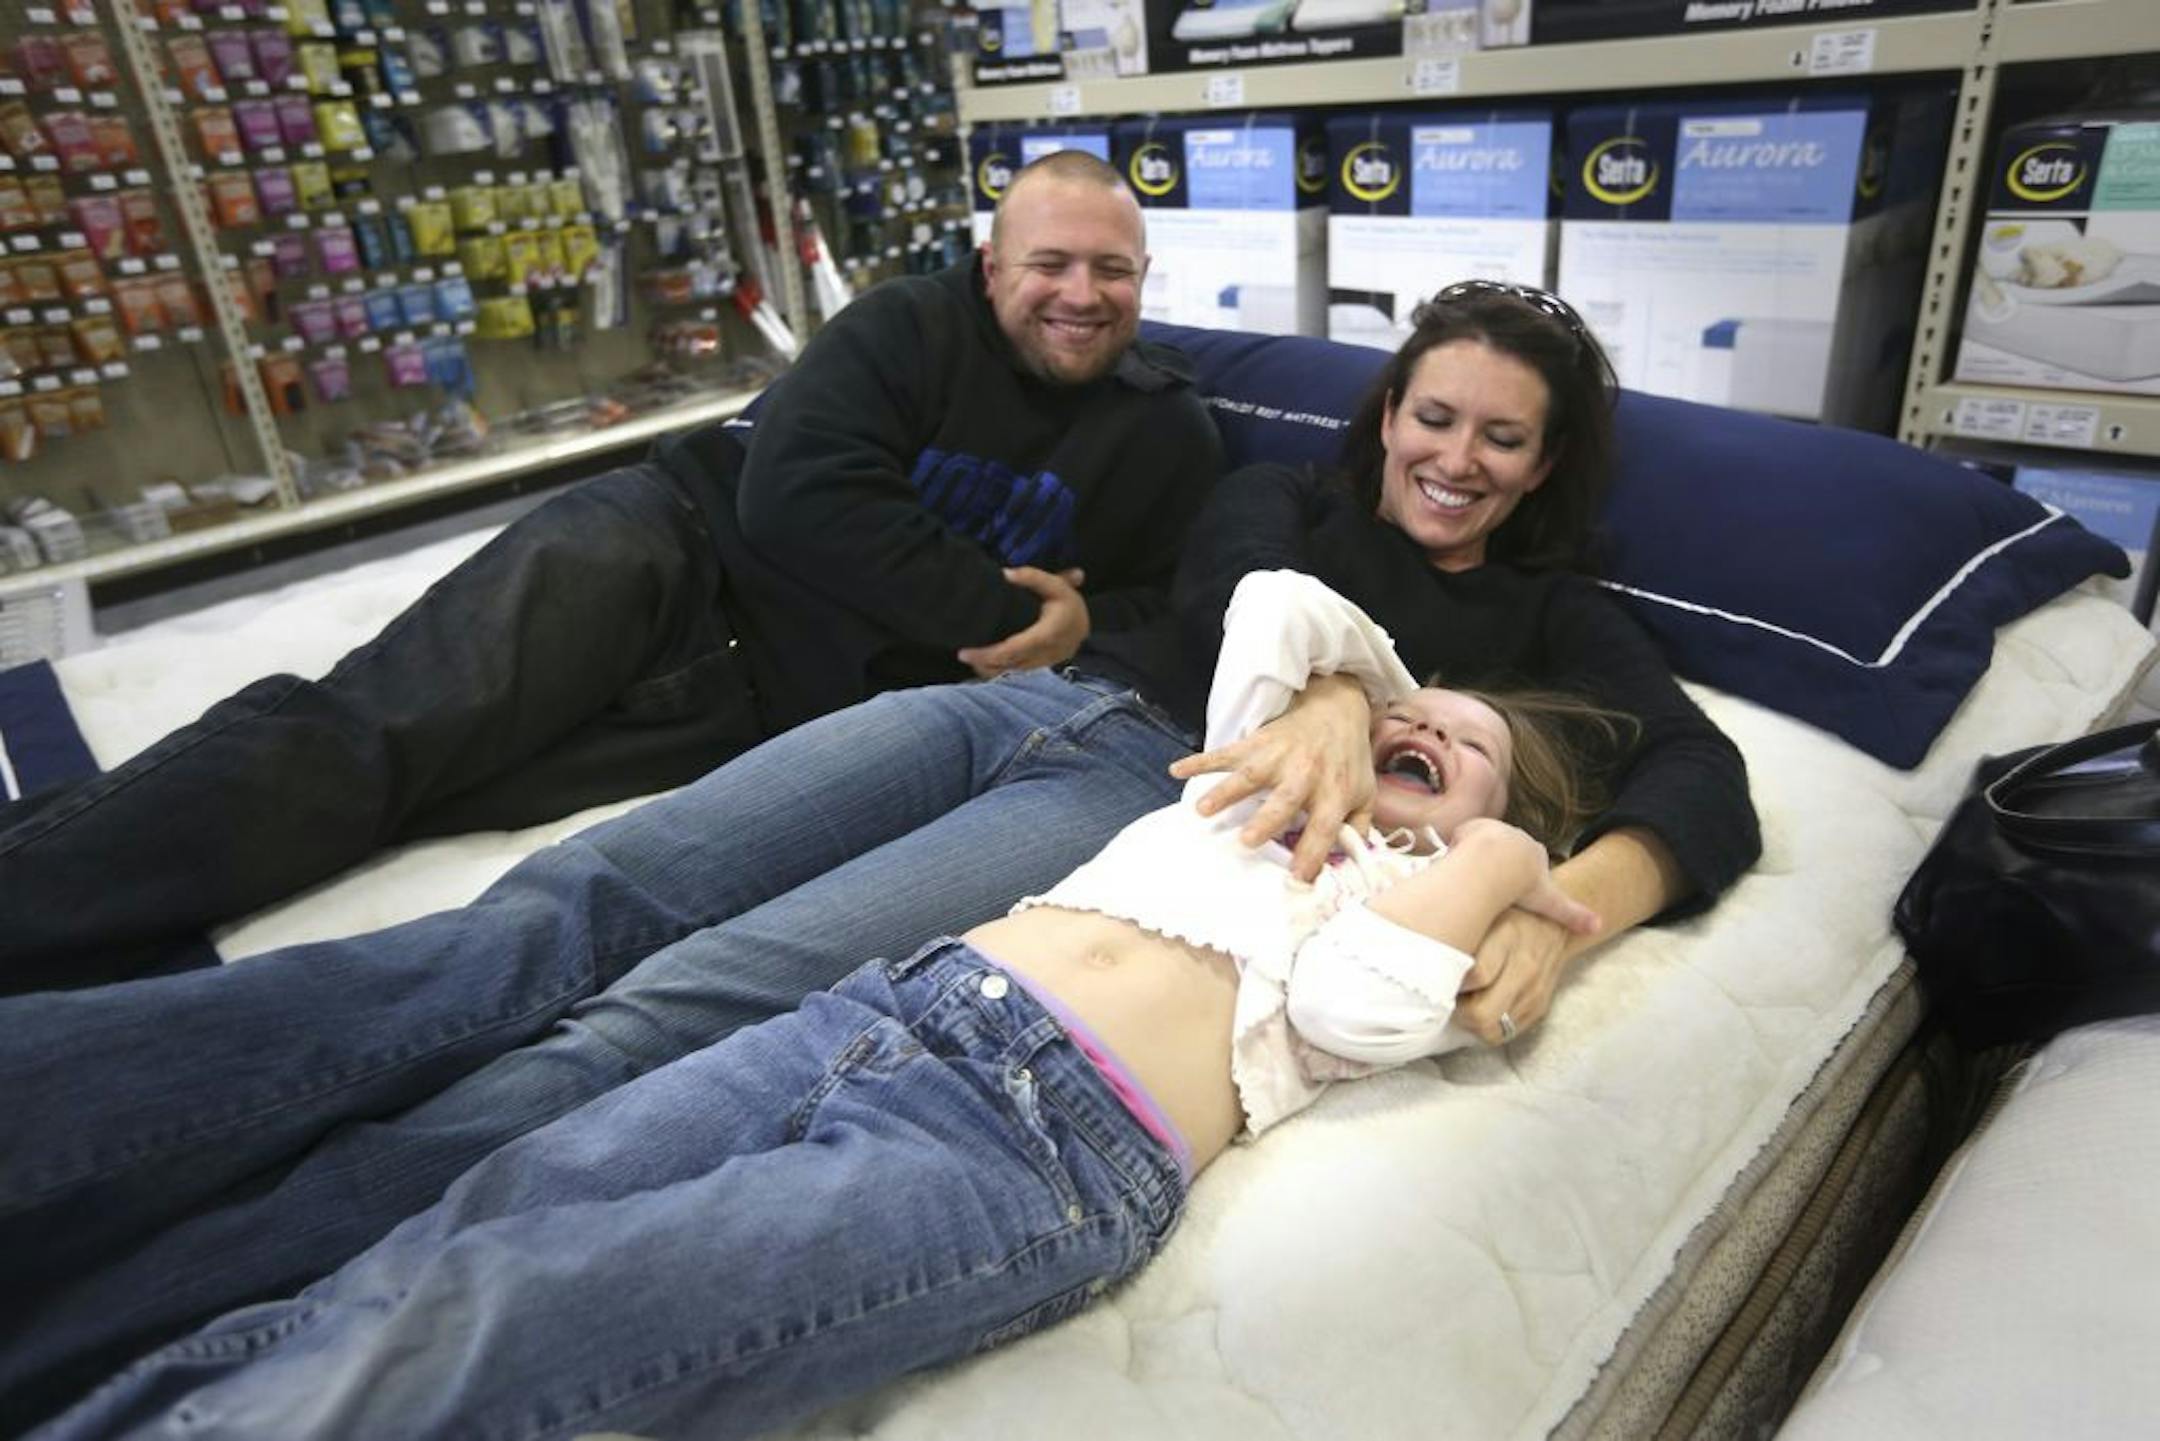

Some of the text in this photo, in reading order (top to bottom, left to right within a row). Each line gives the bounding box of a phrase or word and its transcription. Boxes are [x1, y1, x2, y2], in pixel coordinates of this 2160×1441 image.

[1684, 2, 1752, 22] Memory
[1755, 0, 1805, 16] Foam
[1189, 37, 1353, 64] Memory Foam Mattress Toppers
[1191, 145, 1274, 168] Aurora
[1415, 146, 1524, 171] Aurora
[1678, 138, 1828, 170] Aurora
[1141, 156, 1171, 181] Serta
[1353, 157, 1392, 185] Serta
[1597, 153, 1647, 186] Serta
[2022, 156, 2074, 186] Serta
